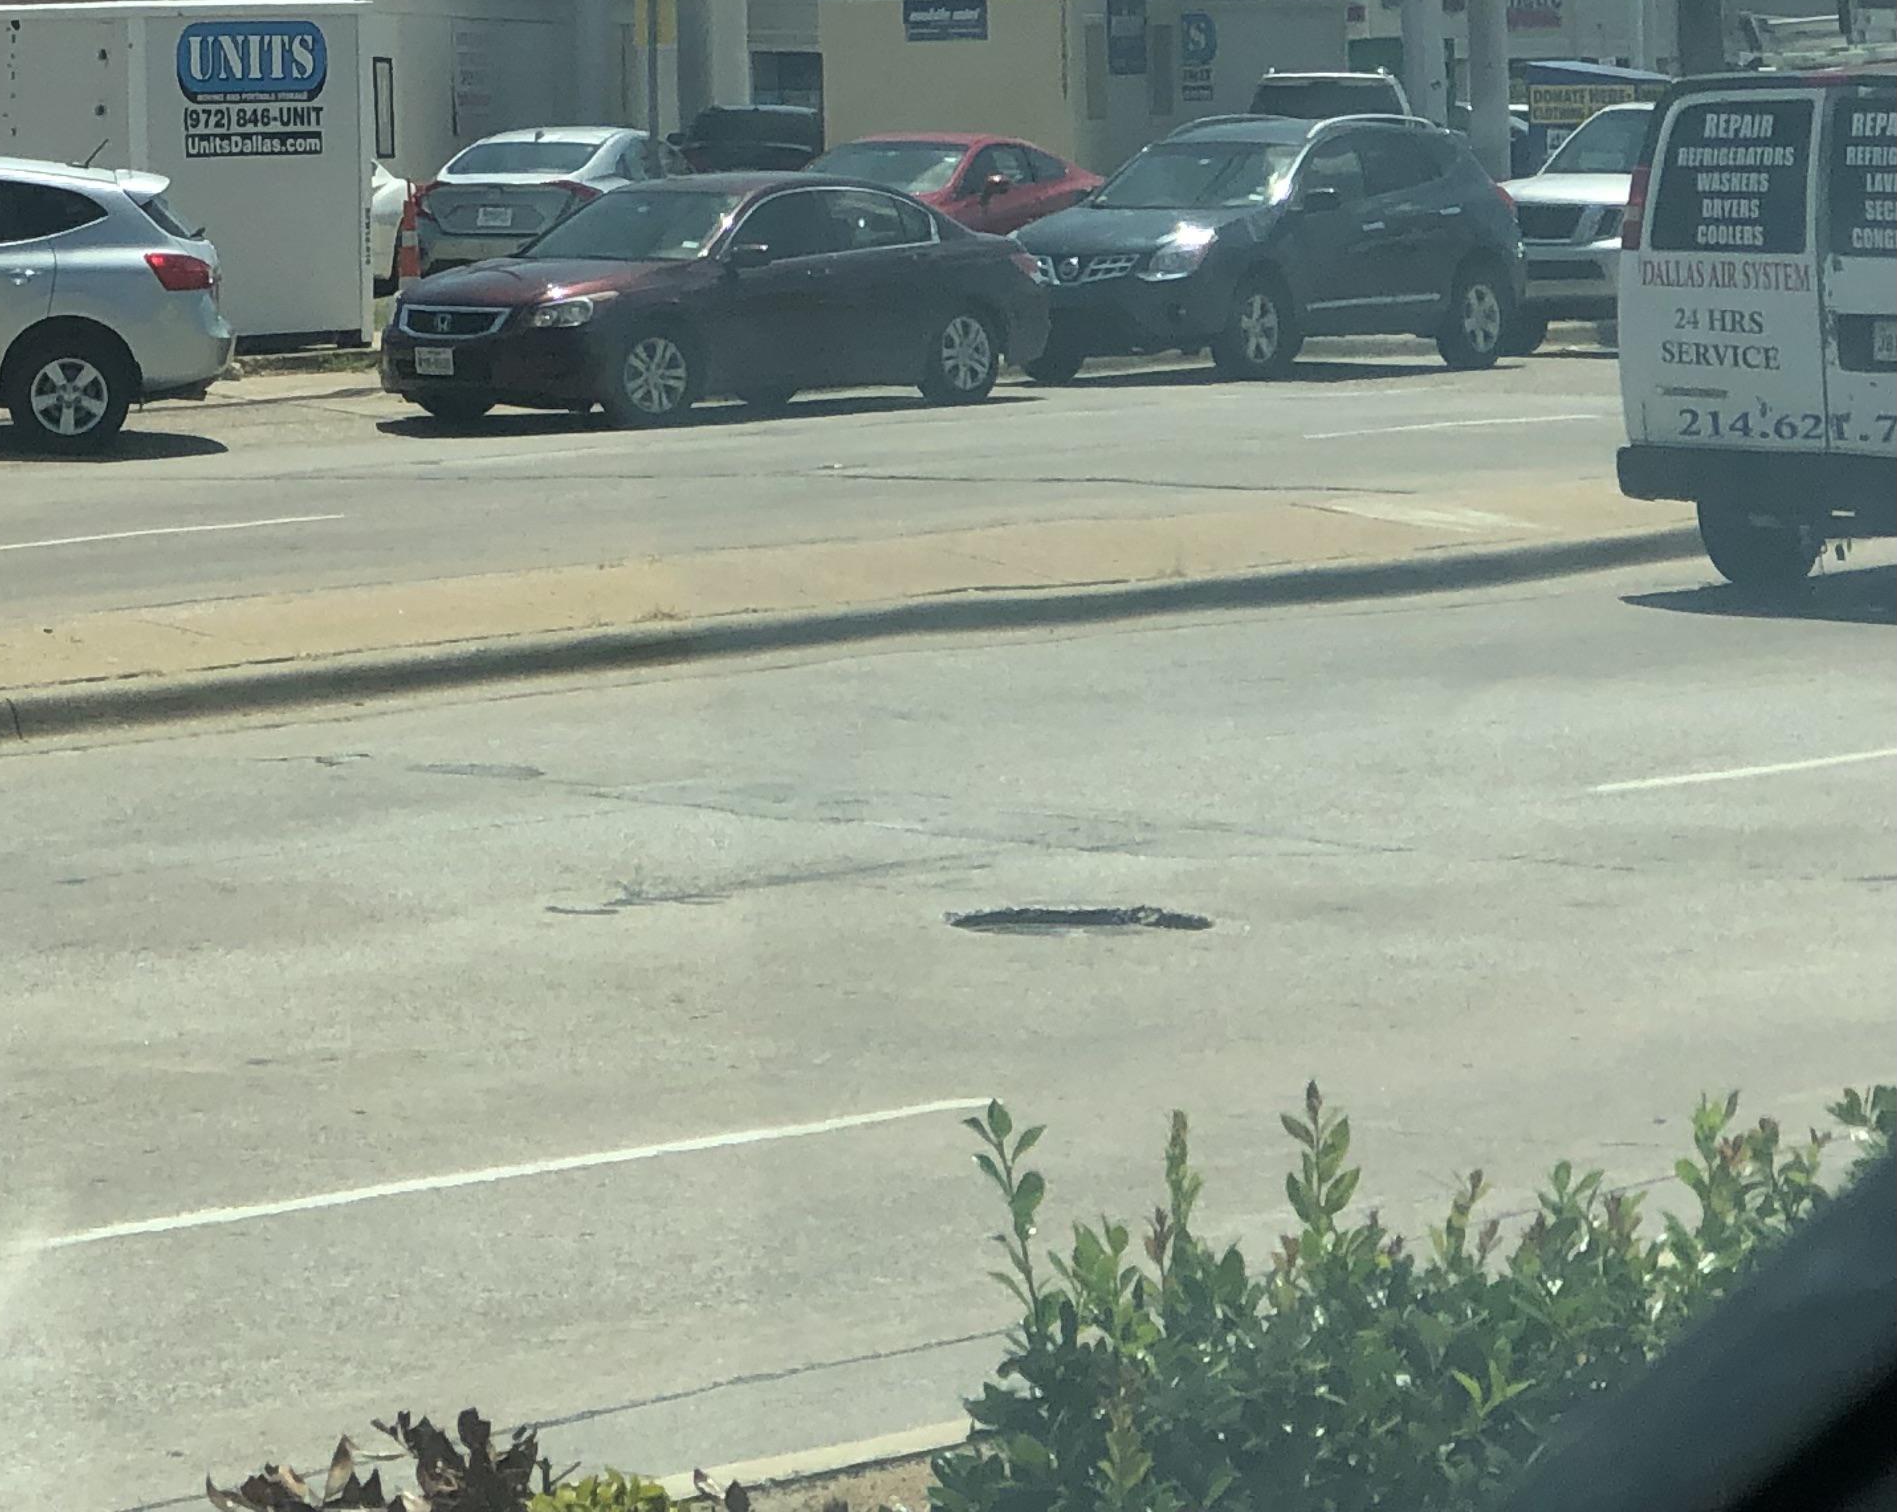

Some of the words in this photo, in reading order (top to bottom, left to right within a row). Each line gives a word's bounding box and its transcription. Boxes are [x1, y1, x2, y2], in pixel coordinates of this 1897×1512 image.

[188, 34, 314, 81] UNITS
[184, 107, 232, 131] (972)
[236, 106, 324, 128] 846-UNIT
[1704, 113, 1774, 138] REPAIR
[187, 135, 321, 155] UnitsDallas.com
[1677, 146, 1795, 166] REFRIGERATORS
[1696, 173, 1770, 192] WASHERS
[1701, 198, 1760, 218] DRYERS
[1696, 225, 1764, 246] COOLERS
[1641, 259, 1704, 288] DALLAS
[1708, 262, 1738, 289] AIR
[1743, 261, 1811, 292] SYSTEM
[1674, 307, 1700, 330] 24
[1708, 309, 1765, 335] HRS
[1661, 339, 1781, 371] SERVICE
